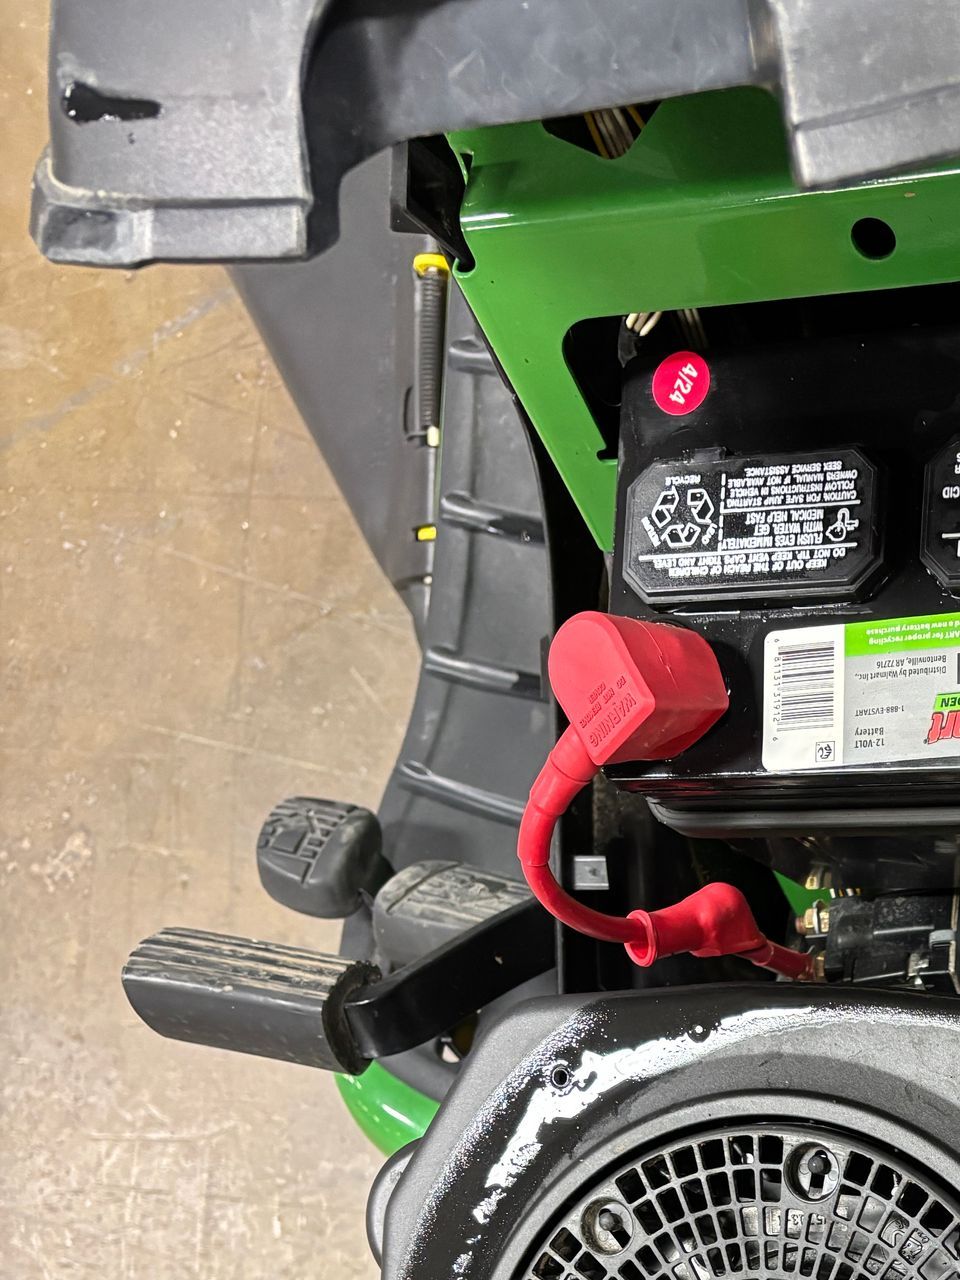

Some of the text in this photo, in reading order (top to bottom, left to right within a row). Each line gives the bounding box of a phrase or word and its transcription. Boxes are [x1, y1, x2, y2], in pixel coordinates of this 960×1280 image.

[669, 363, 698, 404] 4/24
[792, 463, 821, 473] SERVICE
[824, 460, 842, 470] SEEK
[826, 469, 857, 480] OWNERS
[665, 474, 701, 486] RECYCLE
[728, 477, 764, 488] AVAILABLE
[766, 476, 781, 485] NOT
[784, 476, 791, 484] IF
[730, 480, 854, 497] FOLLOW INSTRUCTIONS IN VEHICLE
[727, 497, 762, 507] STARTING
[764, 496, 783, 505] JUMP
[786, 495, 804, 504] SAFE
[806, 493, 821, 502] FOR
[745, 509, 824, 524] MEDICAL HELP FAST
[754, 524, 770, 535] GET
[803, 521, 823, 532] WITH
[721, 533, 823, 549] FLUSH EYES IMMEDIATELY
[772, 551, 793, 561] KEEP
[813, 549, 830, 559] NOT
[833, 548, 846, 557] DO
[679, 558, 696, 567] AND
[698, 556, 721, 566] TIGHT
[724, 554, 746, 564] CAPS
[748, 553, 769, 563] VENT
[653, 559, 676, 568] LEVEL
[669, 559, 827, 576] KEEP OUT OF THE REACH OF CHILDREN
[866, 626, 900, 636] purchase
[902, 624, 930, 634] battery
[869, 636, 903, 645] recycling
[904, 632, 931, 641] proper
[877, 660, 894, 668] 72716
[906, 655, 946, 665] Bentonville,
[870, 670, 898, 679] Walmart
[909, 666, 946, 677] Distributed
[855, 706, 904, 716] 1-888-EVSTART
[590, 693, 636, 747] WARNING
[855, 727, 884, 737] Battery
[854, 739, 884, 748] 12-VOLT
